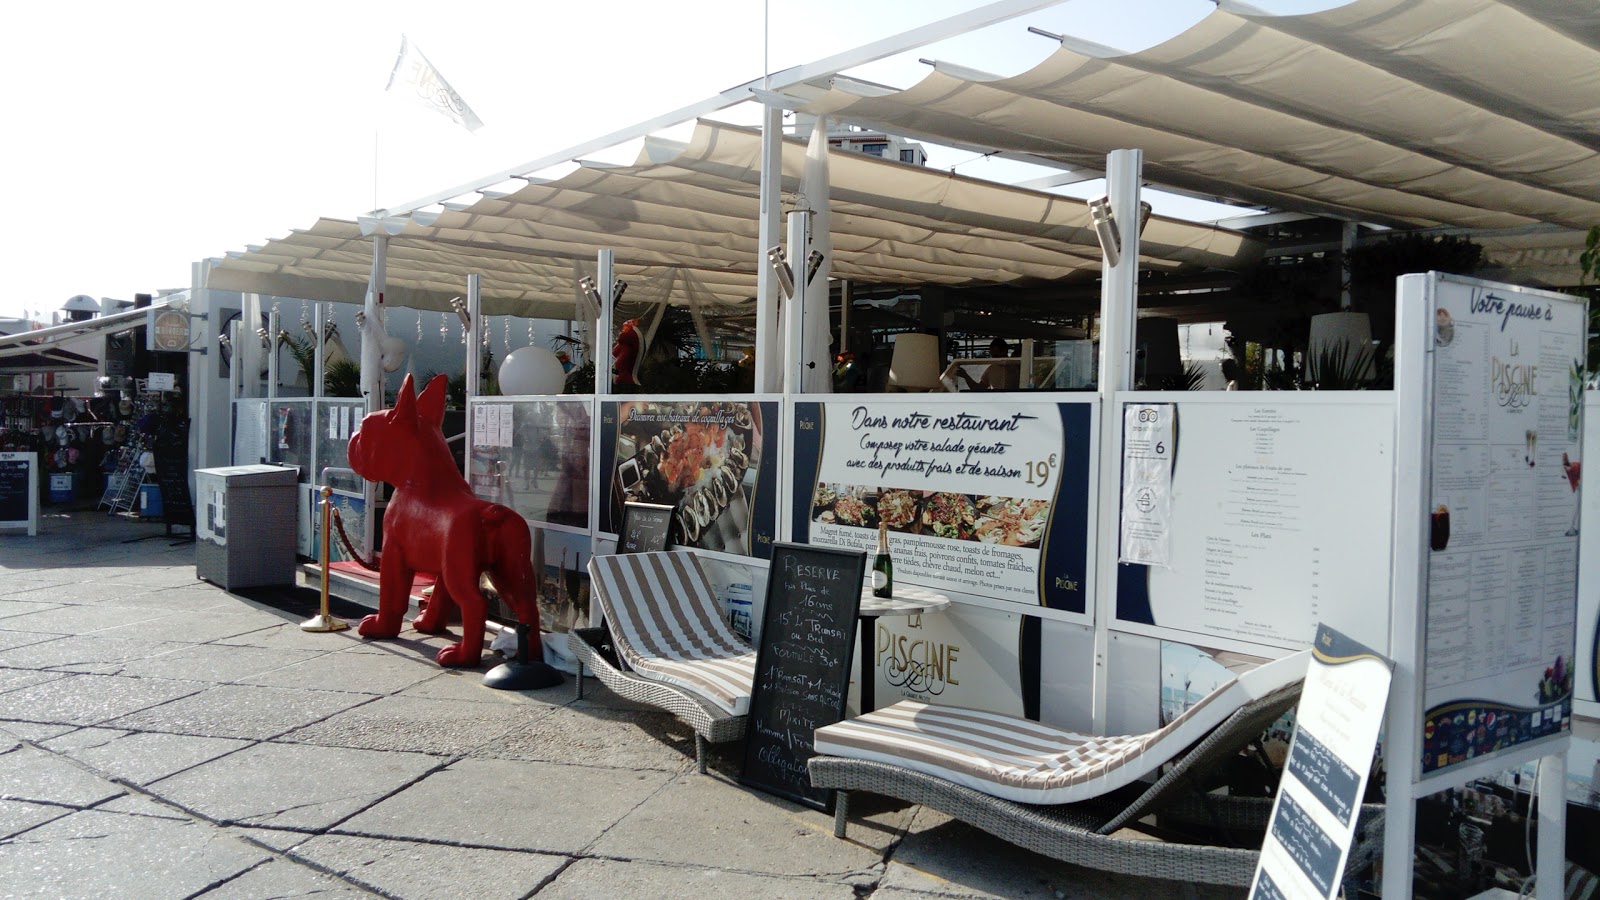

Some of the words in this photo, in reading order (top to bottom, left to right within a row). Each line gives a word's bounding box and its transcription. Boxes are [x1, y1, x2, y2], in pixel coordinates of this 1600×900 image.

[1471, 288, 1506, 314] Votre
[1501, 304, 1543, 332] pause
[1545, 304, 1553, 321] à
[1491, 356, 1538, 396] PISCINE
[691, 410, 699, 423] de
[700, 410, 735, 430] coquillages
[852, 406, 887, 430] Dans
[892, 411, 932, 429] notre
[933, 411, 1039, 431] restaurant
[860, 433, 903, 458] Composez
[905, 439, 931, 450] votre
[930, 438, 965, 452] salade
[965, 442, 1012, 465] géante
[1156, 441, 1165, 454] 6
[846, 459, 866, 468] avec
[867, 455, 882, 470] des
[881, 457, 932, 478] produits
[925, 459, 952, 477] frais
[956, 463, 976, 474] et
[968, 460, 982, 475] de
[984, 465, 1021, 478] saison
[813, 536, 838, 545] mozzarella
[839, 538, 846, 546] Di
[894, 548, 913, 556] ananas
[914, 547, 928, 558] frais,
[929, 550, 955, 562] poivrons
[956, 554, 978, 565] confits,
[980, 557, 1005, 569] tomates
[820, 526, 838, 538] Magret
[854, 531, 869, 540] toasts
[870, 532, 877, 540] de
[889, 537, 902, 545] gras,
[903, 537, 945, 550] pamplemousse
[963, 546, 980, 554] toasts
[982, 546, 990, 555] de
[991, 547, 1023, 562] fromages,
[922, 560, 942, 570] chèvre
[943, 562, 962, 574] chaud,
[964, 564, 984, 577] melon
[799, 595, 817, 607] 16
[1022, 587, 1035, 595] clients
[908, 614, 922, 629] LA
[877, 623, 959, 685] PISCINE
